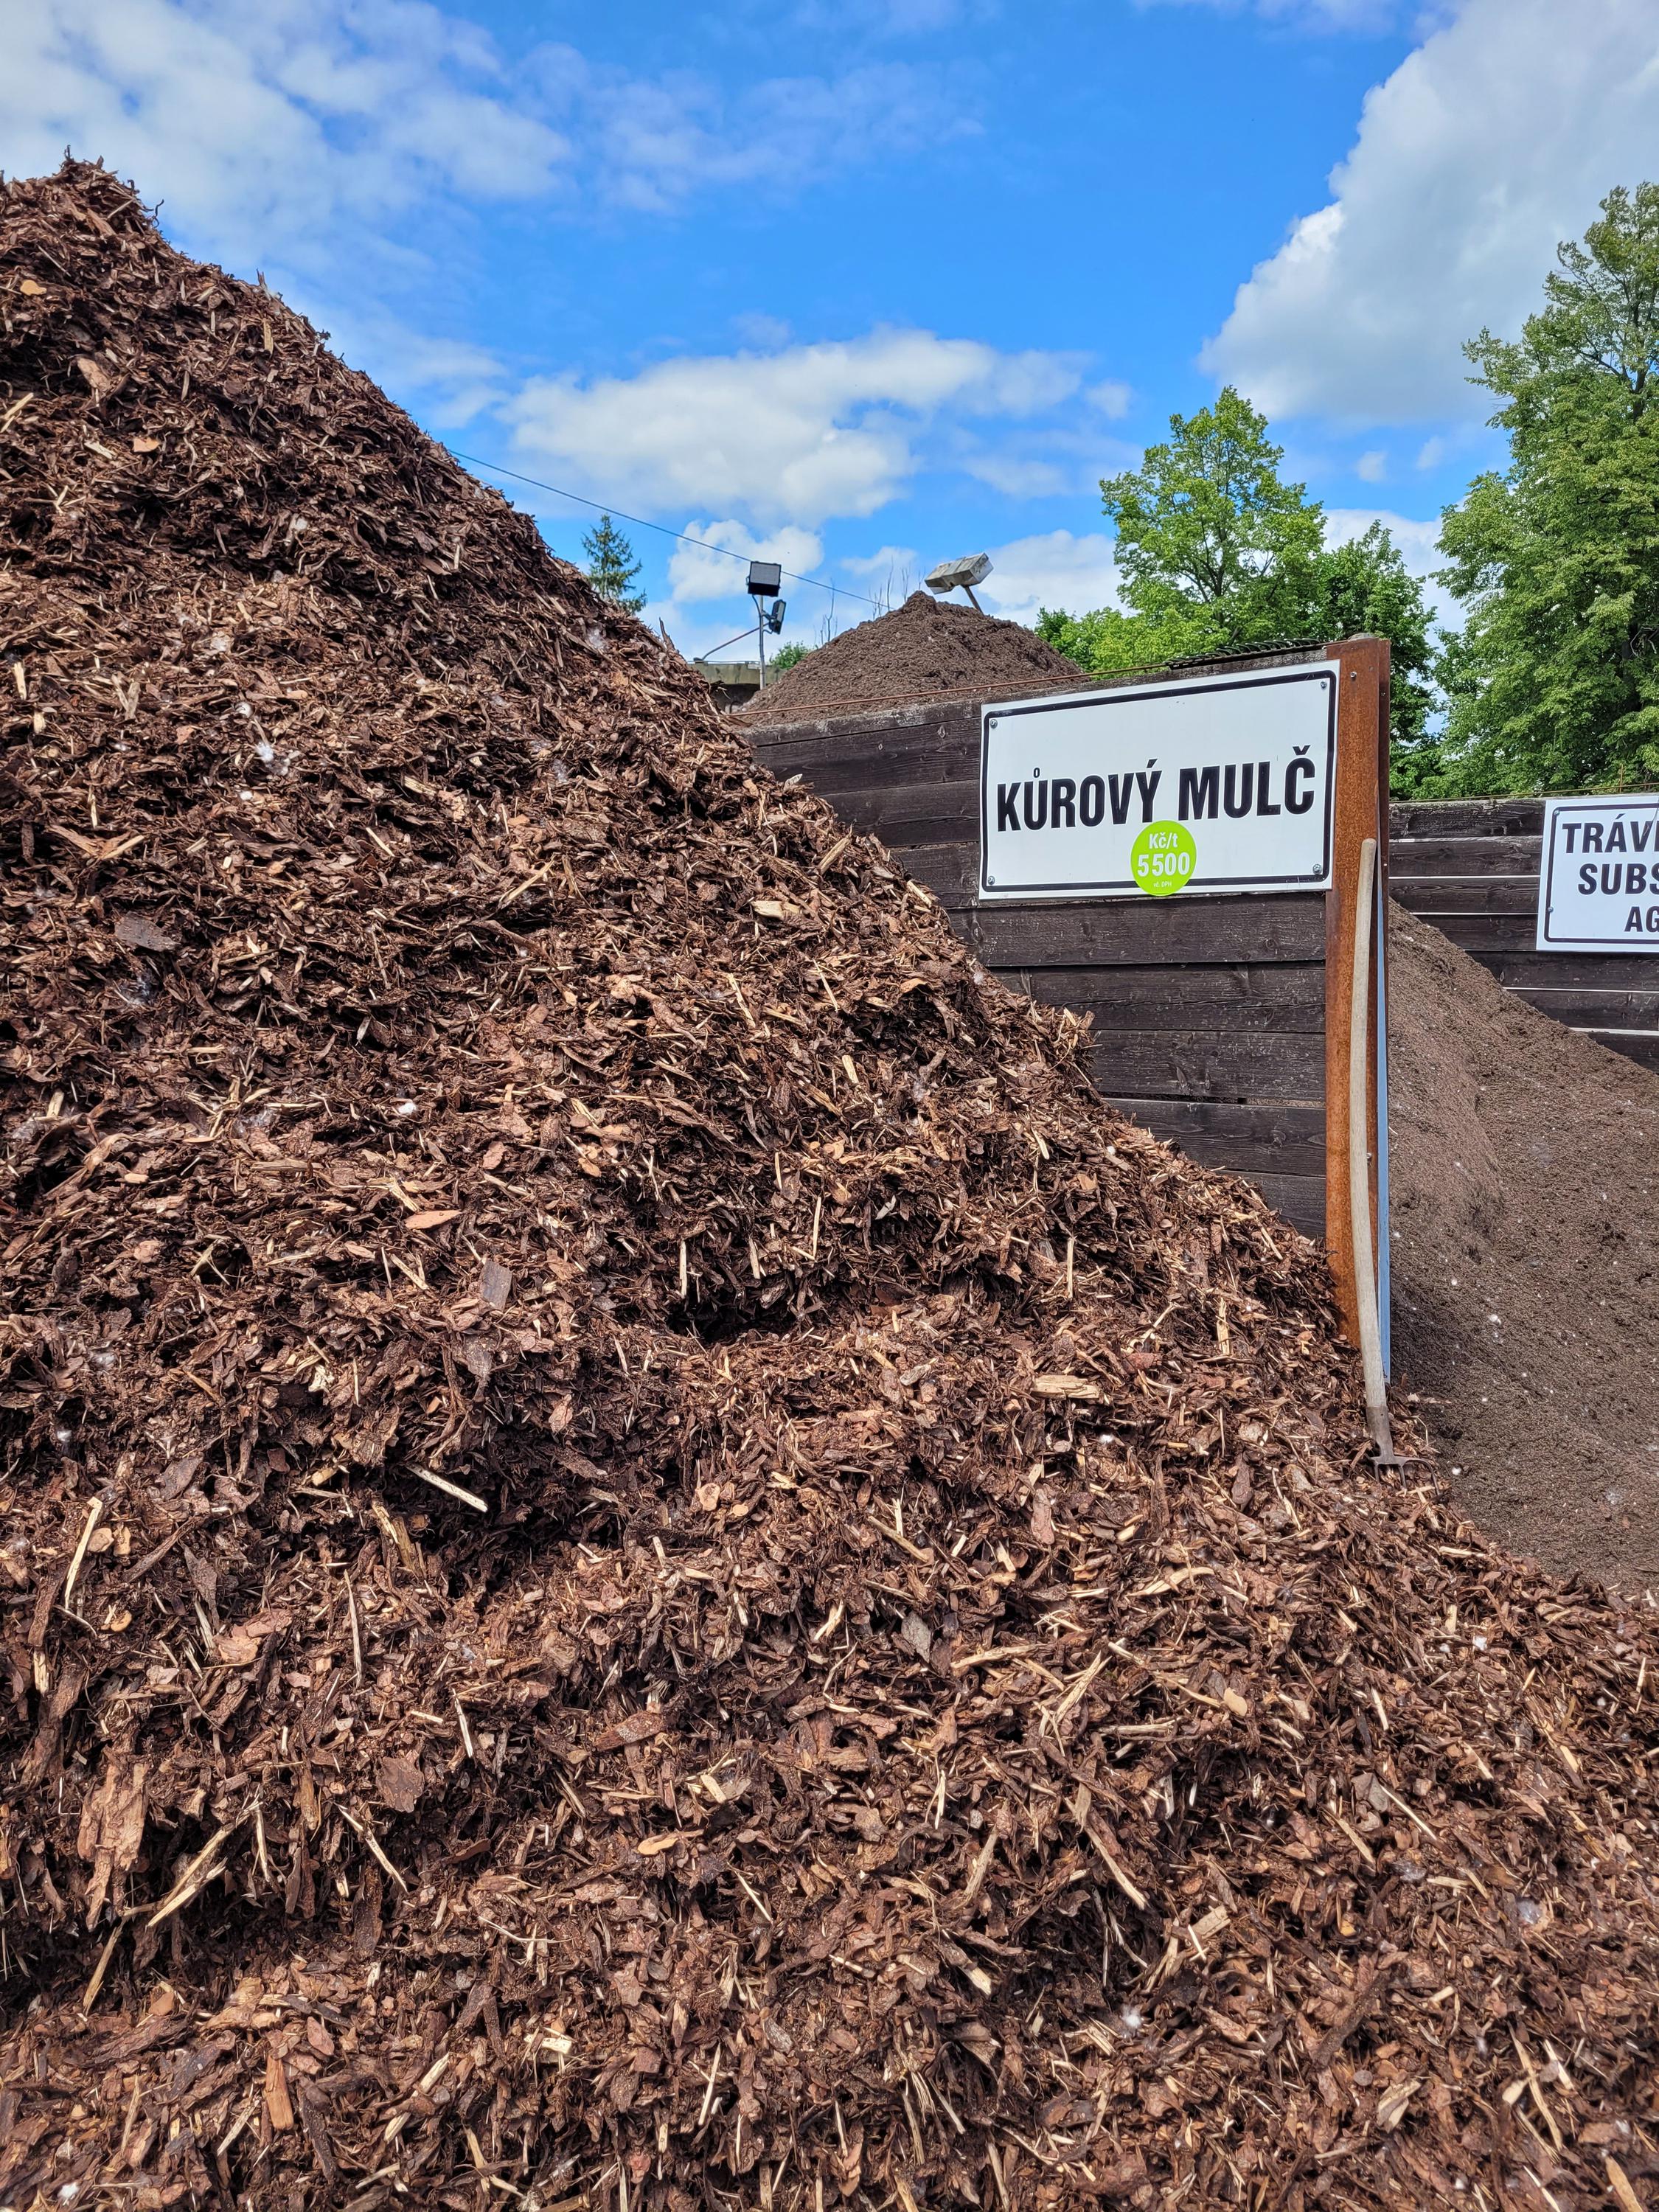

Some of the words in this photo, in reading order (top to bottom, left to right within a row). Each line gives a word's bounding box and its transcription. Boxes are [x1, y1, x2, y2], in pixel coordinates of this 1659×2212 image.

[997, 758, 1163, 832] KŮROVÝ
[1178, 745, 1316, 821] MULČ
[1149, 832, 1178, 849] Kč/t
